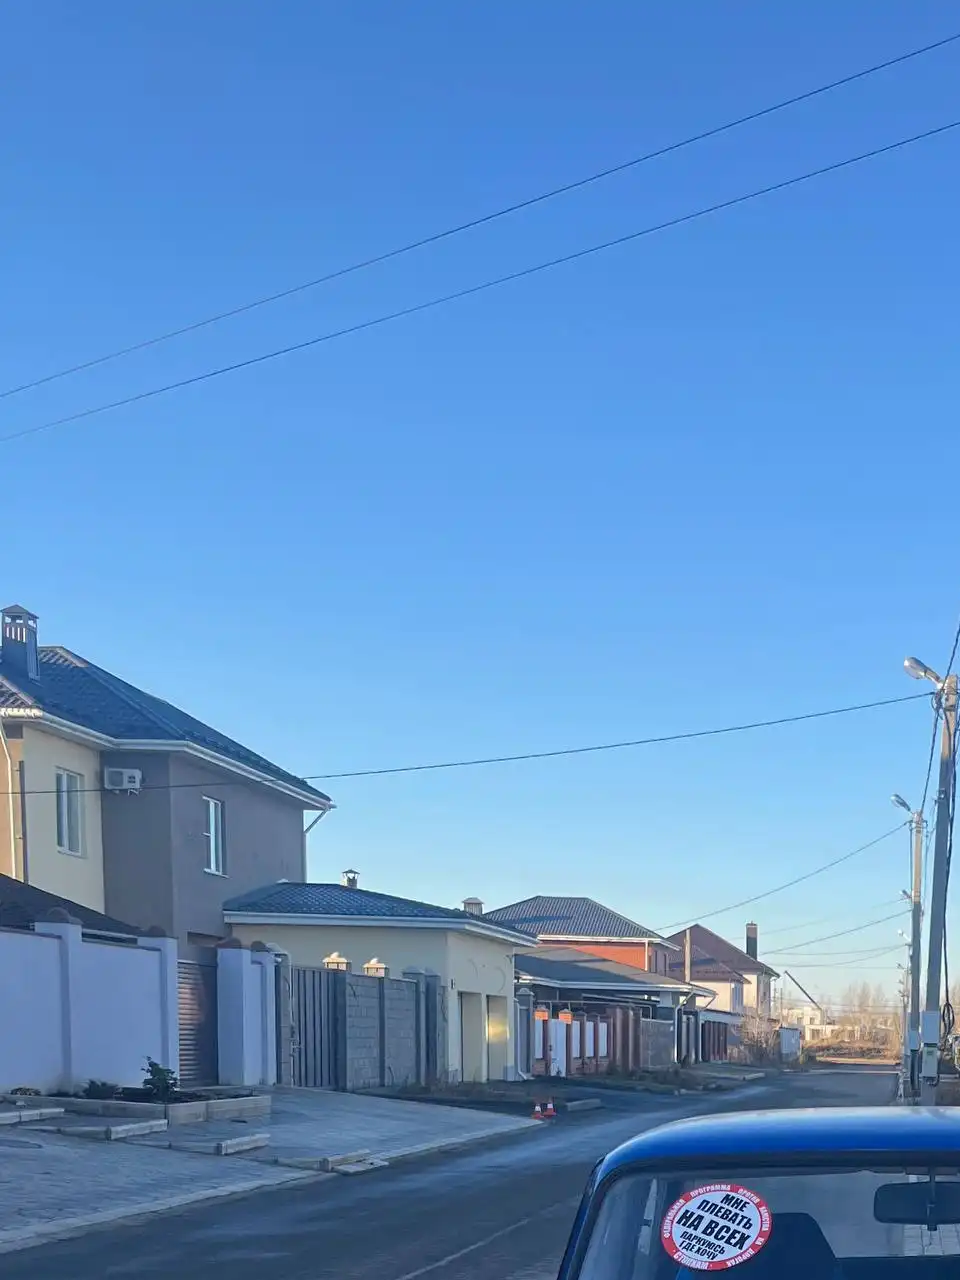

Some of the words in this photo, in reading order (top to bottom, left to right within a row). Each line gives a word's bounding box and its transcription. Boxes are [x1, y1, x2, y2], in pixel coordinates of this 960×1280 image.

[690, 1184, 731, 1198] ПРОГРАММА
[737, 1188, 761, 1203] ПРОТИВ
[720, 1193, 750, 1212] МНЕ
[696, 1199, 753, 1230] ПЛЕВАТЬ
[676, 1209, 704, 1231] НА
[701, 1219, 751, 1250] ВСЕХ
[679, 1240, 695, 1252] ГДЕ
[694, 1246, 719, 1260] ХОЧУ
[680, 1231, 726, 1255] ПАРКУЮСЬ
[673, 1251, 709, 1270] СТОПХАМ
[726, 1247, 755, 1267] ДОРОГАХ
